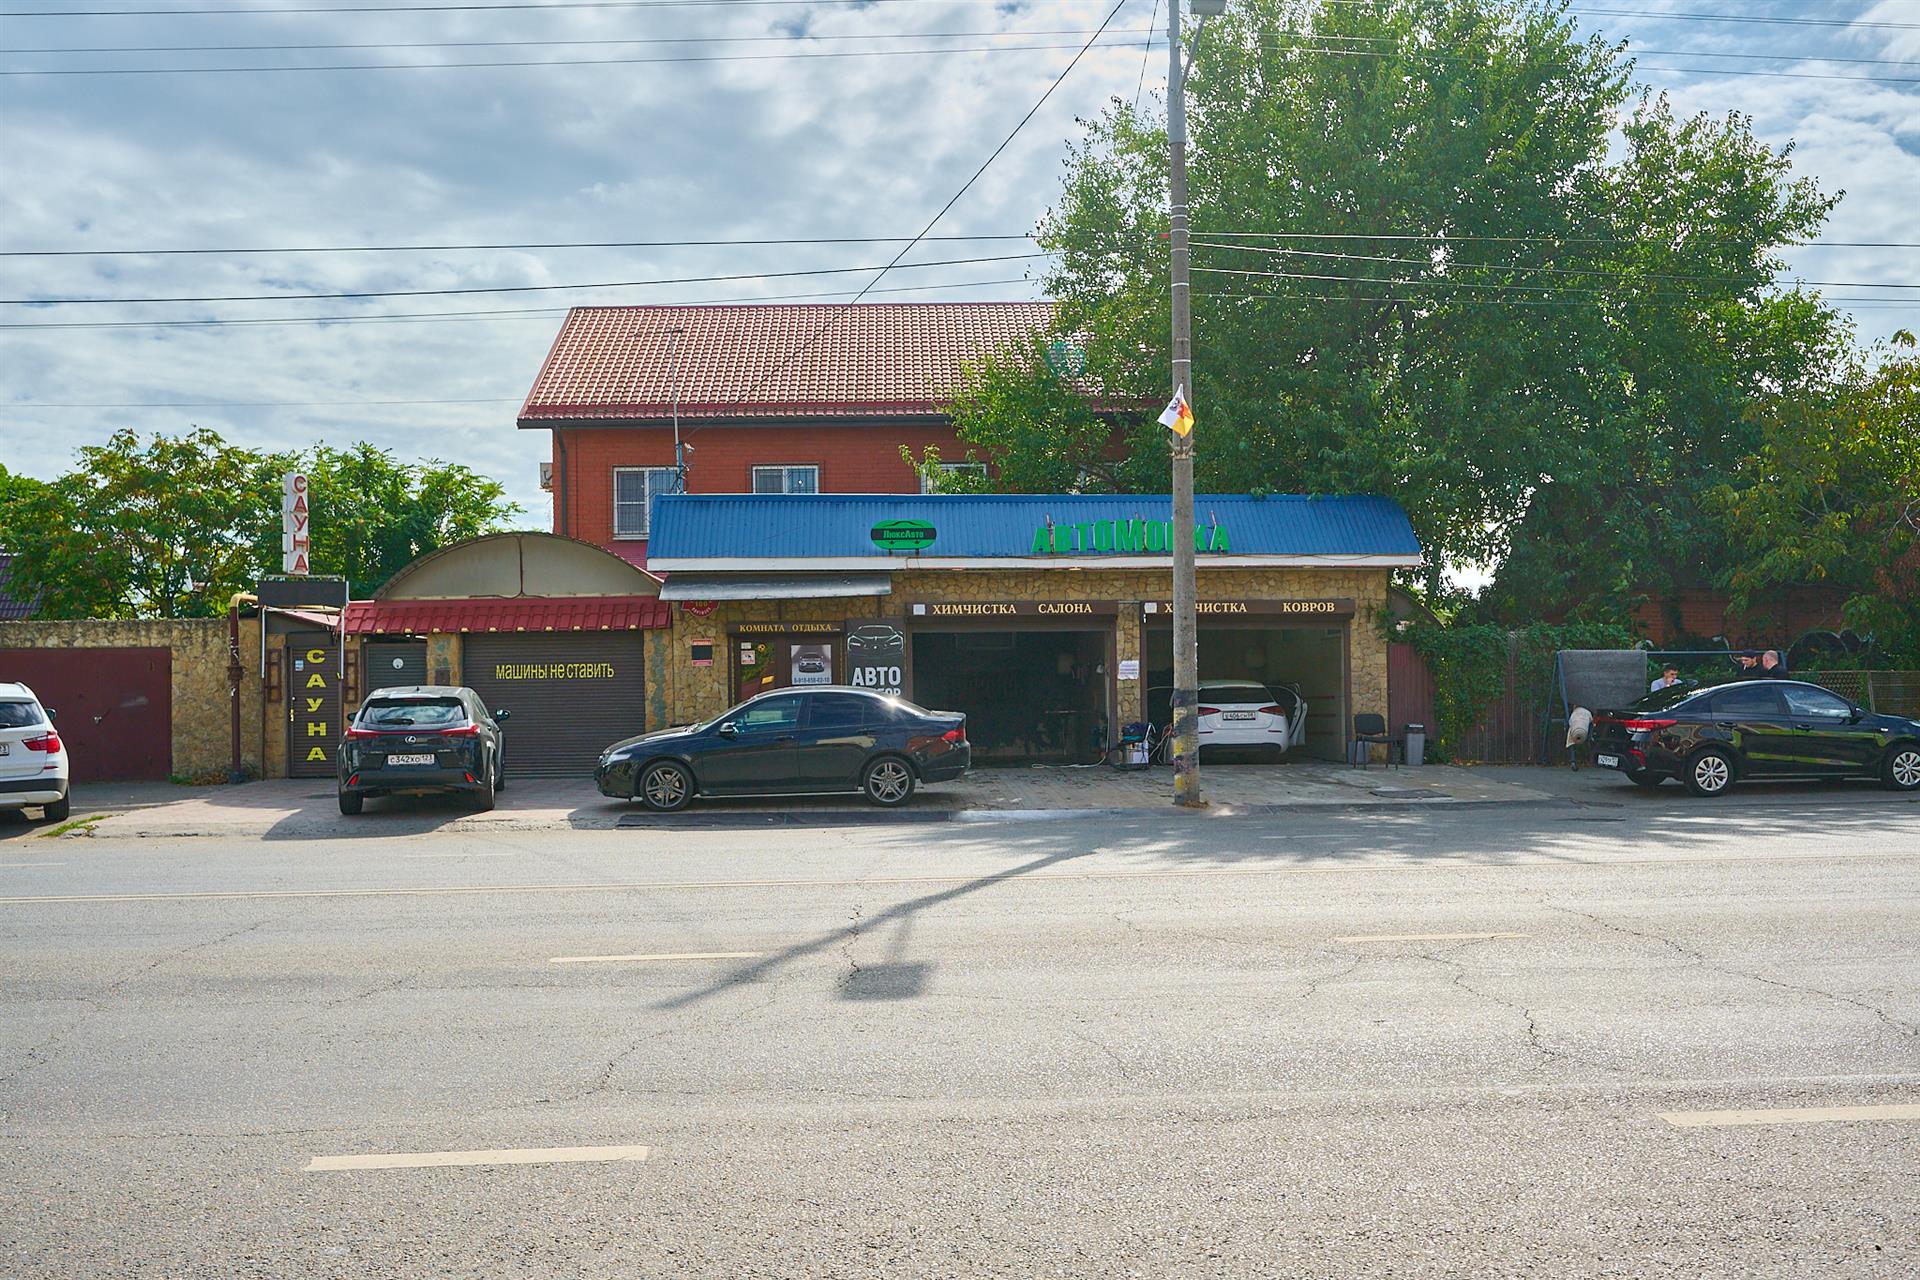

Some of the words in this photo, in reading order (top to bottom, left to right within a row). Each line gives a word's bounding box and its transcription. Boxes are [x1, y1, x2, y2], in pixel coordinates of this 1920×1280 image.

[292, 475, 309, 572] САУНА
[932, 604, 1017, 615] ХИМЧИСТКА
[1038, 603, 1092, 614] САЛОНА
[1164, 602, 1247, 613] ХЧИСТКА
[1283, 602, 1335, 613] КОВРОВ
[740, 623, 785, 632] КОМНАТА
[792, 623, 832, 632] ОТДЫХА
[496, 664, 548, 679] машины
[550, 664, 565, 678] не
[567, 663, 615, 678] ставить
[852, 666, 901, 686] АВТО
[306, 649, 327, 761] САУНА
